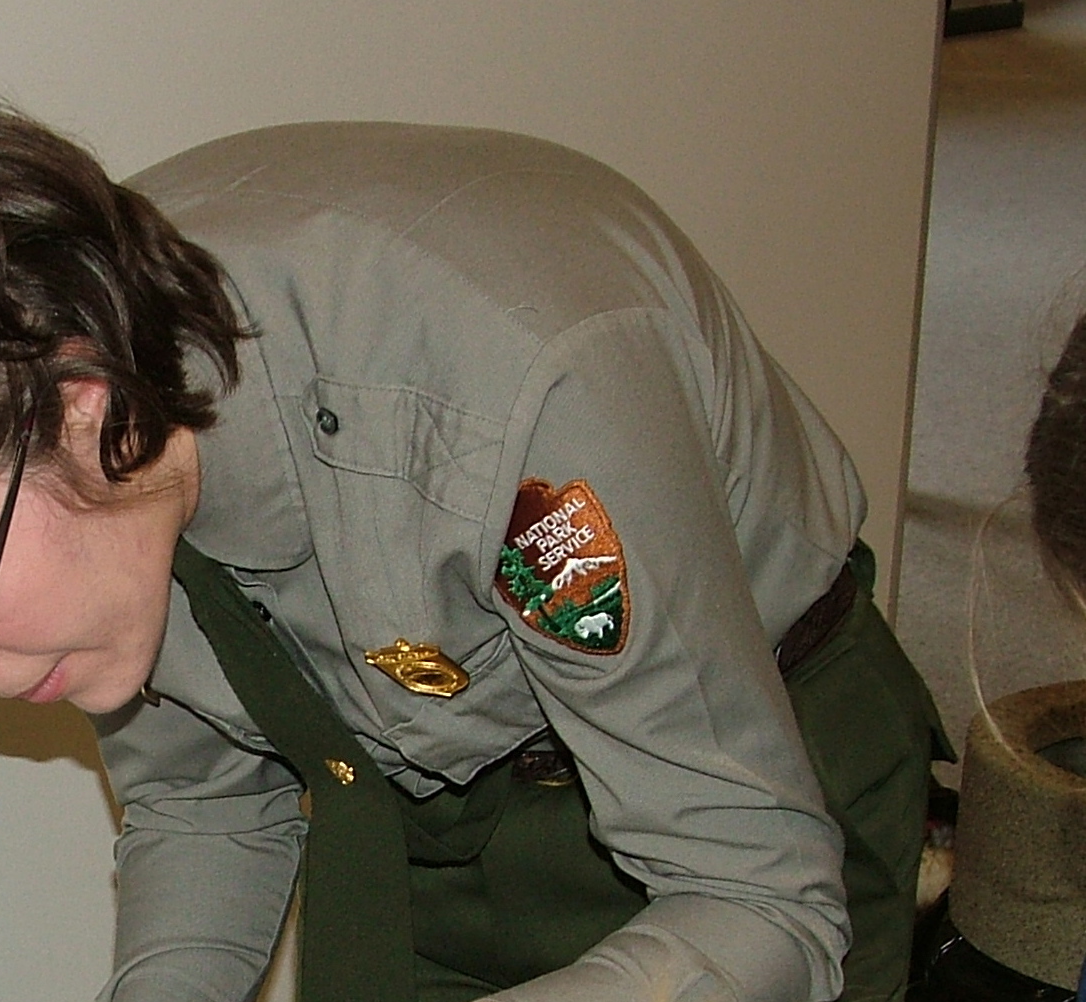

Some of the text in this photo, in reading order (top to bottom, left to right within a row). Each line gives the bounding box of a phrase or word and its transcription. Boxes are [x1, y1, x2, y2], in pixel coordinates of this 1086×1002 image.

[514, 497, 586, 550] NATIONAL
[536, 521, 578, 553] PARK
[538, 524, 595, 571] SERVICE
